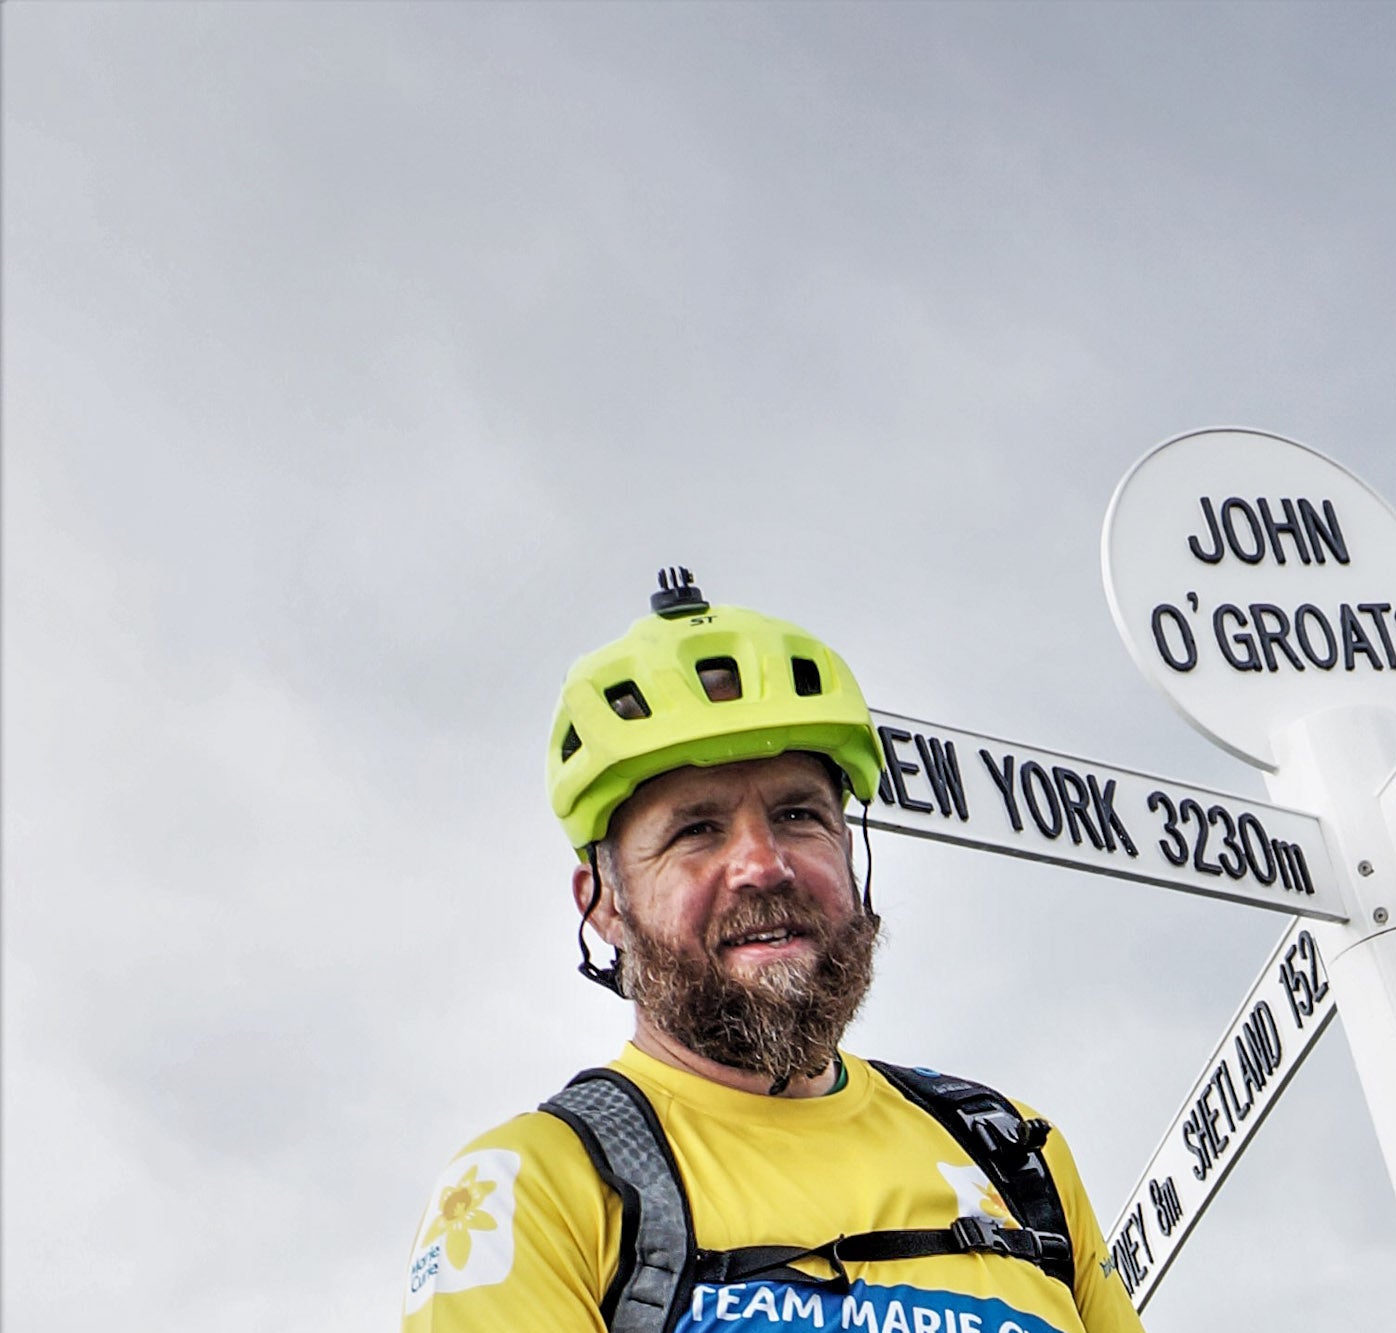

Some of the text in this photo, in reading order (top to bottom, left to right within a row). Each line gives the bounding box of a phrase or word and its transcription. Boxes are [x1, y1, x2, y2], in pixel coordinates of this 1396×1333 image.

[1187, 496, 1351, 566] JOHN
[978, 748, 1139, 858] YORK
[1147, 790, 1315, 895] 3230m
[1112, 1203, 1154, 1299] NEY
[1148, 1176, 1184, 1237] 8m
[1182, 1000, 1282, 1182] SHETLAND
[692, 1283, 824, 1329] TEAM
